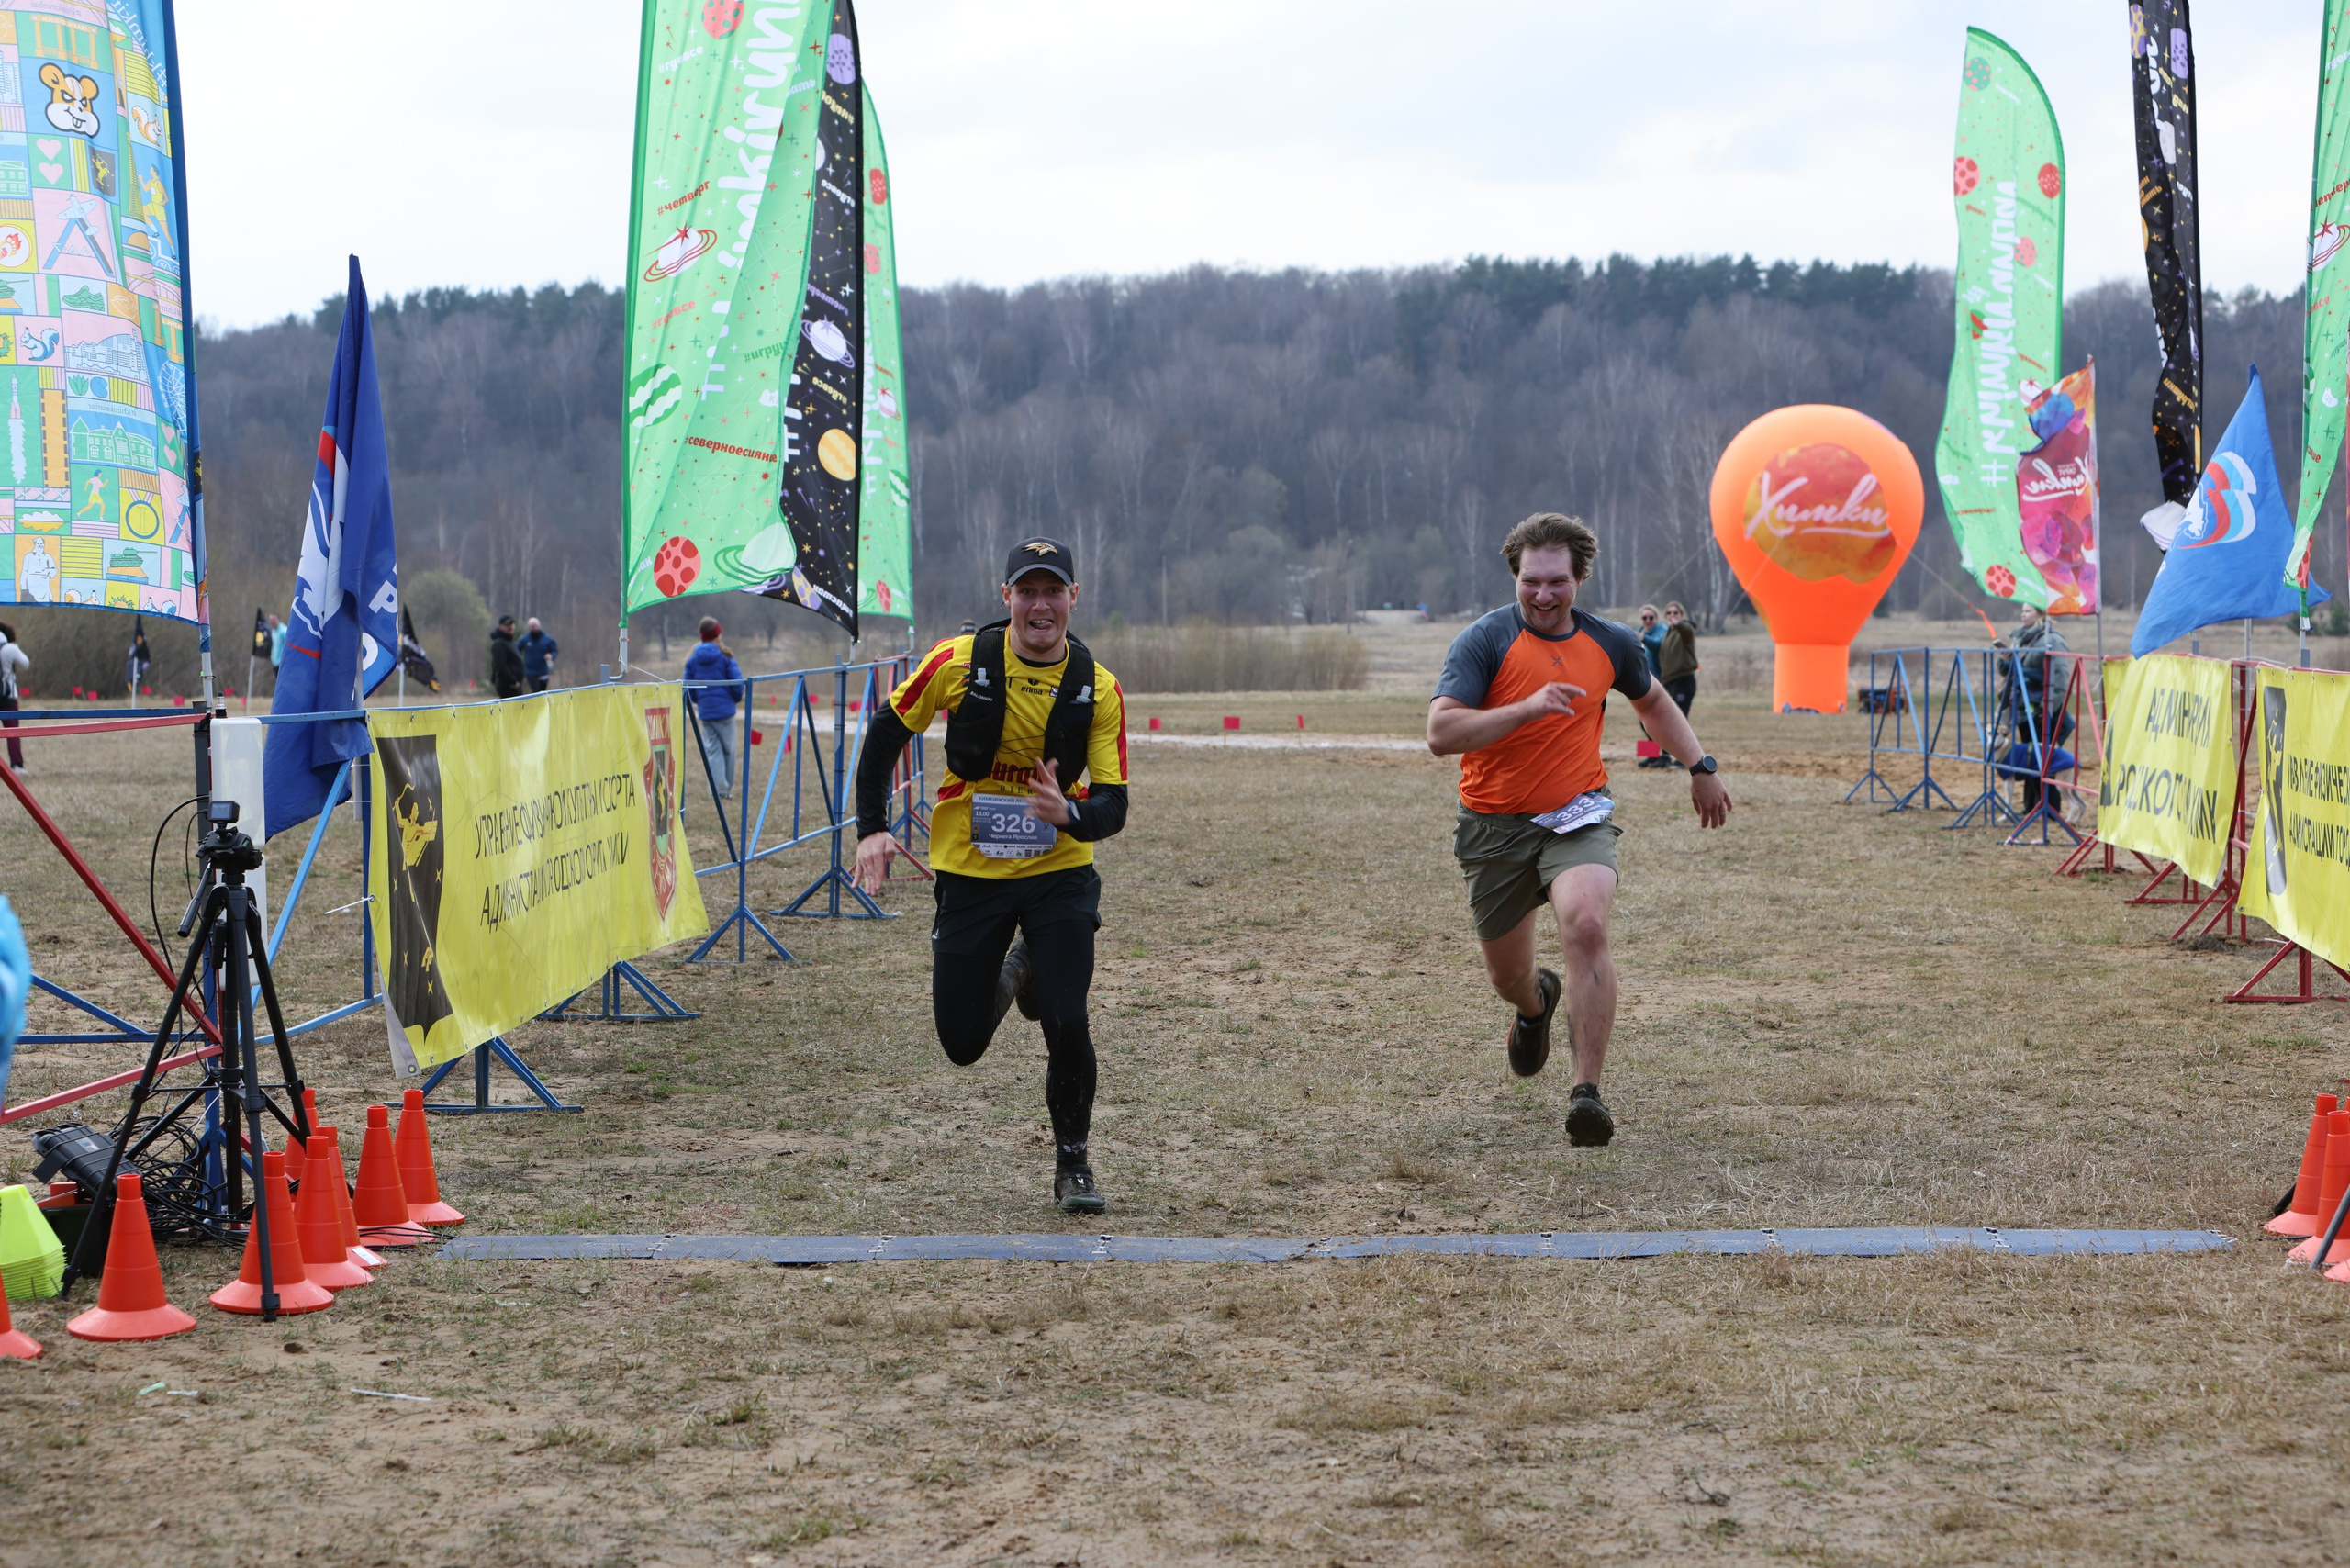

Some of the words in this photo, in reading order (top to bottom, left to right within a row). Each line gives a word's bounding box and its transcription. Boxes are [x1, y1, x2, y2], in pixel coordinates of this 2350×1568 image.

[1744, 470, 1891, 541] Химки
[970, 690, 993, 702] SALOMON
[1021, 685, 1043, 696] erima
[1000, 784, 1034, 795] BIER
[978, 795, 1015, 803] ХИМКИНСКИЙ
[1556, 797, 1595, 822] 333
[990, 813, 1036, 834] 326
